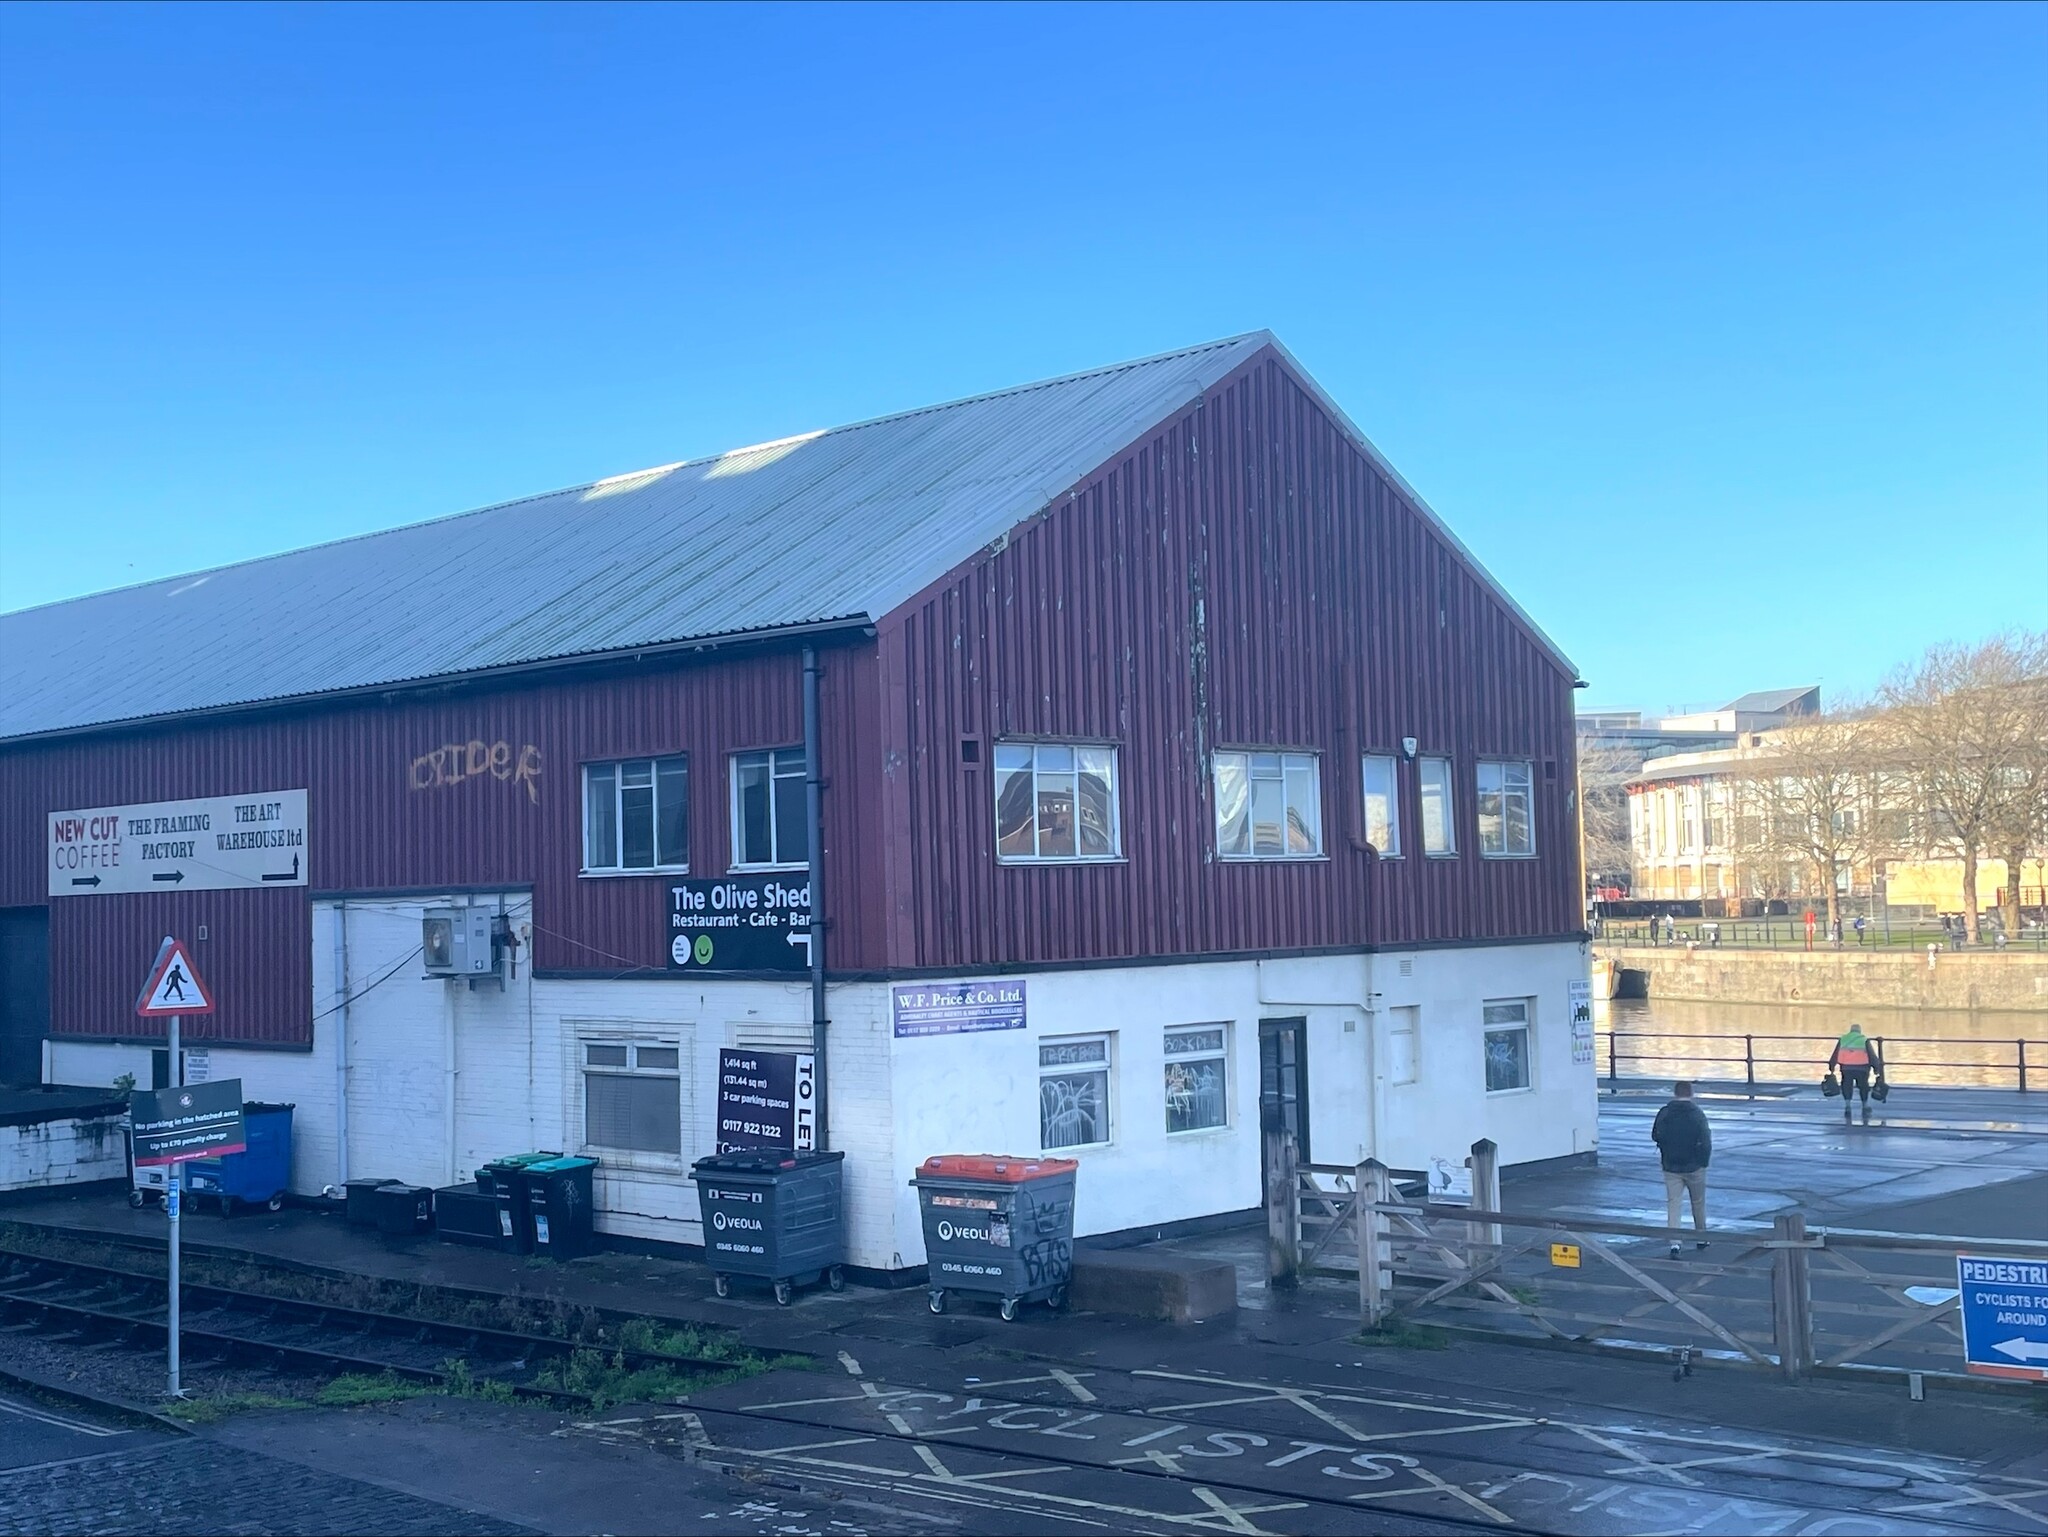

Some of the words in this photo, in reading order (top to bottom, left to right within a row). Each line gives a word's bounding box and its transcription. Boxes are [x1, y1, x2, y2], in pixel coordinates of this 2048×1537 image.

[235, 805, 257, 823] THE
[258, 802, 281, 821] ART
[54, 819, 86, 843] NEW
[128, 819, 151, 836] THE
[153, 814, 210, 834] FRAMING
[216, 829, 285, 852] WAREHOUSE
[55, 843, 120, 870] COFFEE
[142, 841, 195, 860] FACTORY
[671, 886, 705, 911] The
[711, 884, 758, 910] Olive
[764, 882, 811, 909] Shed
[672, 913, 739, 927] Restaurant
[750, 911, 778, 926] Cafe
[789, 911, 811, 926] Bar
[932, 992, 963, 1006] Price
[965, 992, 976, 1004] &
[978, 990, 997, 1004] Co.
[1000, 989, 1023, 1002] Ltd.
[741, 1061, 750, 1070] sq
[751, 1060, 757, 1070] ft
[748, 1079, 756, 1088] sq
[757, 1079, 767, 1089] m)
[799, 1063, 812, 1099] TO
[723, 1091, 729, 1100] 3
[741, 1095, 766, 1107] parking
[767, 1099, 789, 1109] spaces
[135, 1122, 145, 1130] No
[146, 1119, 174, 1131] parking
[175, 1118, 182, 1126] in
[195, 1111, 222, 1122] hatched
[224, 1110, 239, 1118] area
[722, 1119, 742, 1132] 0117
[743, 1122, 760, 1135] 922
[761, 1125, 781, 1138] 1222
[182, 1136, 205, 1146] penalty
[206, 1132, 227, 1141] charge
[727, 1217, 762, 1231] VEOLIA
[954, 1226, 991, 1241] VEOLI
[942, 1263, 962, 1272] 0345
[963, 1265, 984, 1274] 6060
[985, 1267, 1002, 1276] 460
[1976, 1292, 2031, 1308] CYCLISTS
[1997, 1311, 2047, 1326] AROUND
[876, 1393, 1421, 1481] CYCLISTS
